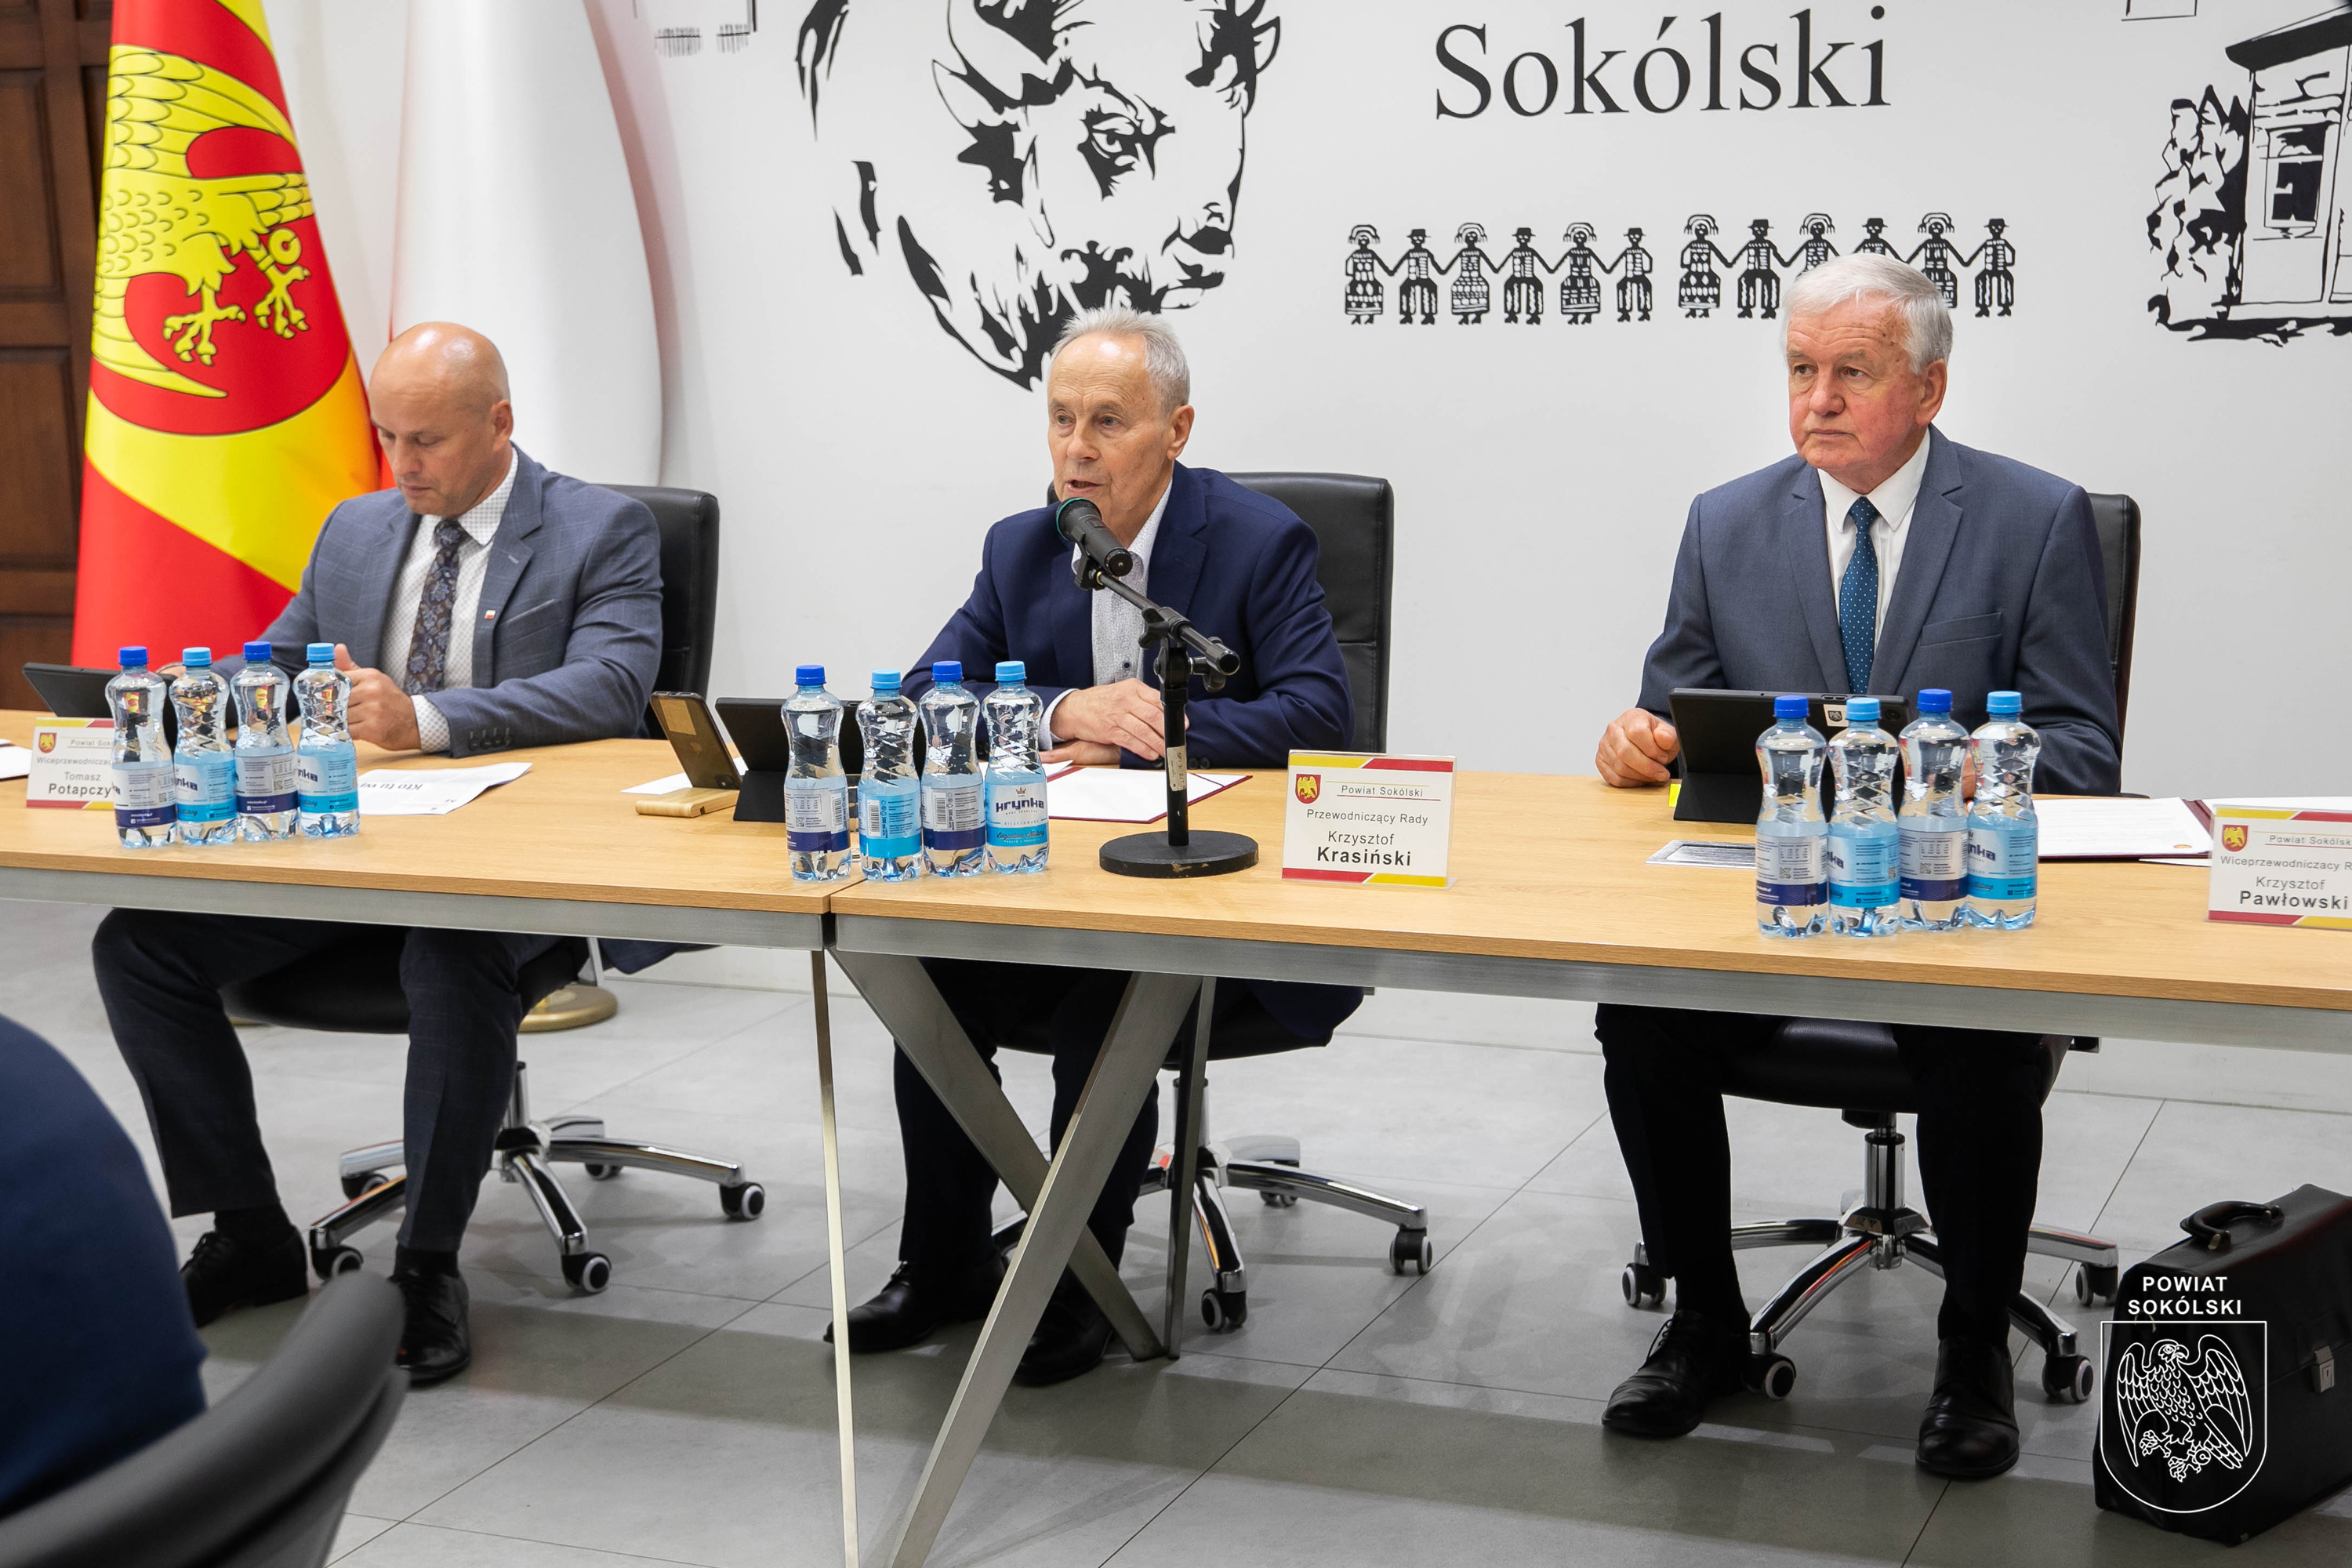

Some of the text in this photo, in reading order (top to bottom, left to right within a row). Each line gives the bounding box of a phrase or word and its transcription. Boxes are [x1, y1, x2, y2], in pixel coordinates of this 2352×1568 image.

[1435, 5, 1891, 120] Sokólski
[64, 771, 101, 782] Tomasz
[49, 782, 113, 798] Potapczy
[1341, 785, 1424, 797] Powiat Sokólski
[995, 797, 1045, 814] krynka
[1307, 809, 1428, 826] Przewodniczący Rady
[1328, 830, 1395, 847] Krzysztof
[2269, 834, 2351, 846] Powiat Sokólsk
[1317, 847, 1411, 866] Krasiński
[2256, 876, 2325, 891] Krzysztof
[2239, 891, 2348, 909] Pawłowski
